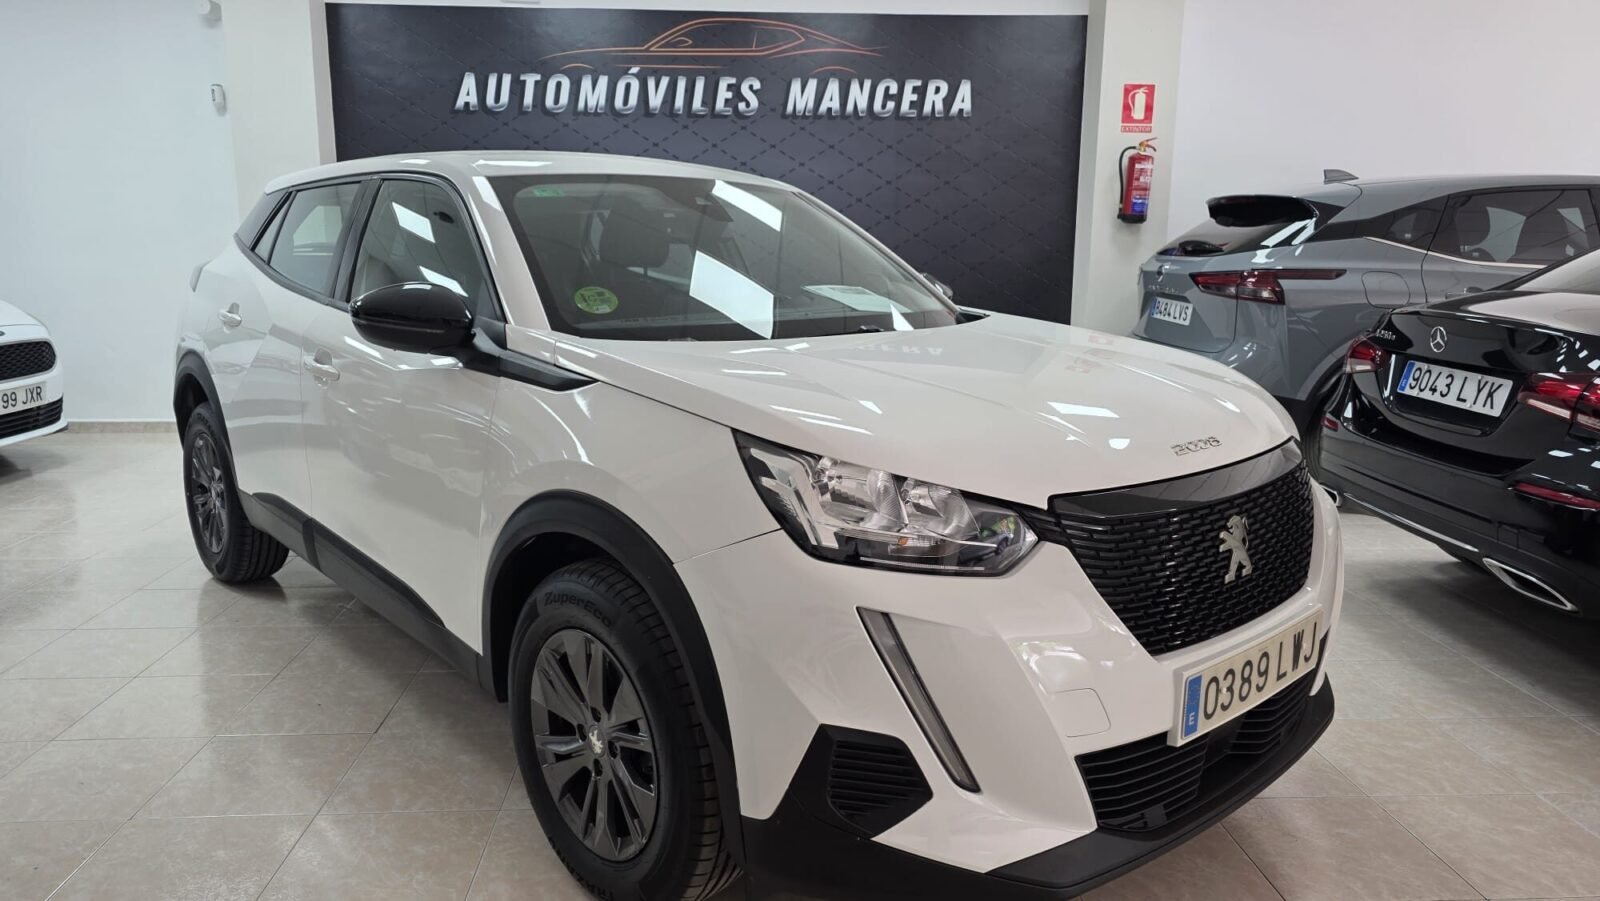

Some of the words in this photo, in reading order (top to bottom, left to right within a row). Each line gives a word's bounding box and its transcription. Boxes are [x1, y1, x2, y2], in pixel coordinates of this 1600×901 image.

[455, 67, 761, 116] AUTOMÓVILES
[785, 78, 973, 117] MANCERA
[1173, 303, 1189, 321] LVS
[22, 386, 43, 405] JXR
[1409, 367, 1454, 398] 9043
[1456, 376, 1503, 410] LYK
[1203, 651, 1270, 720] 0389
[1276, 621, 1317, 681] LWJ
